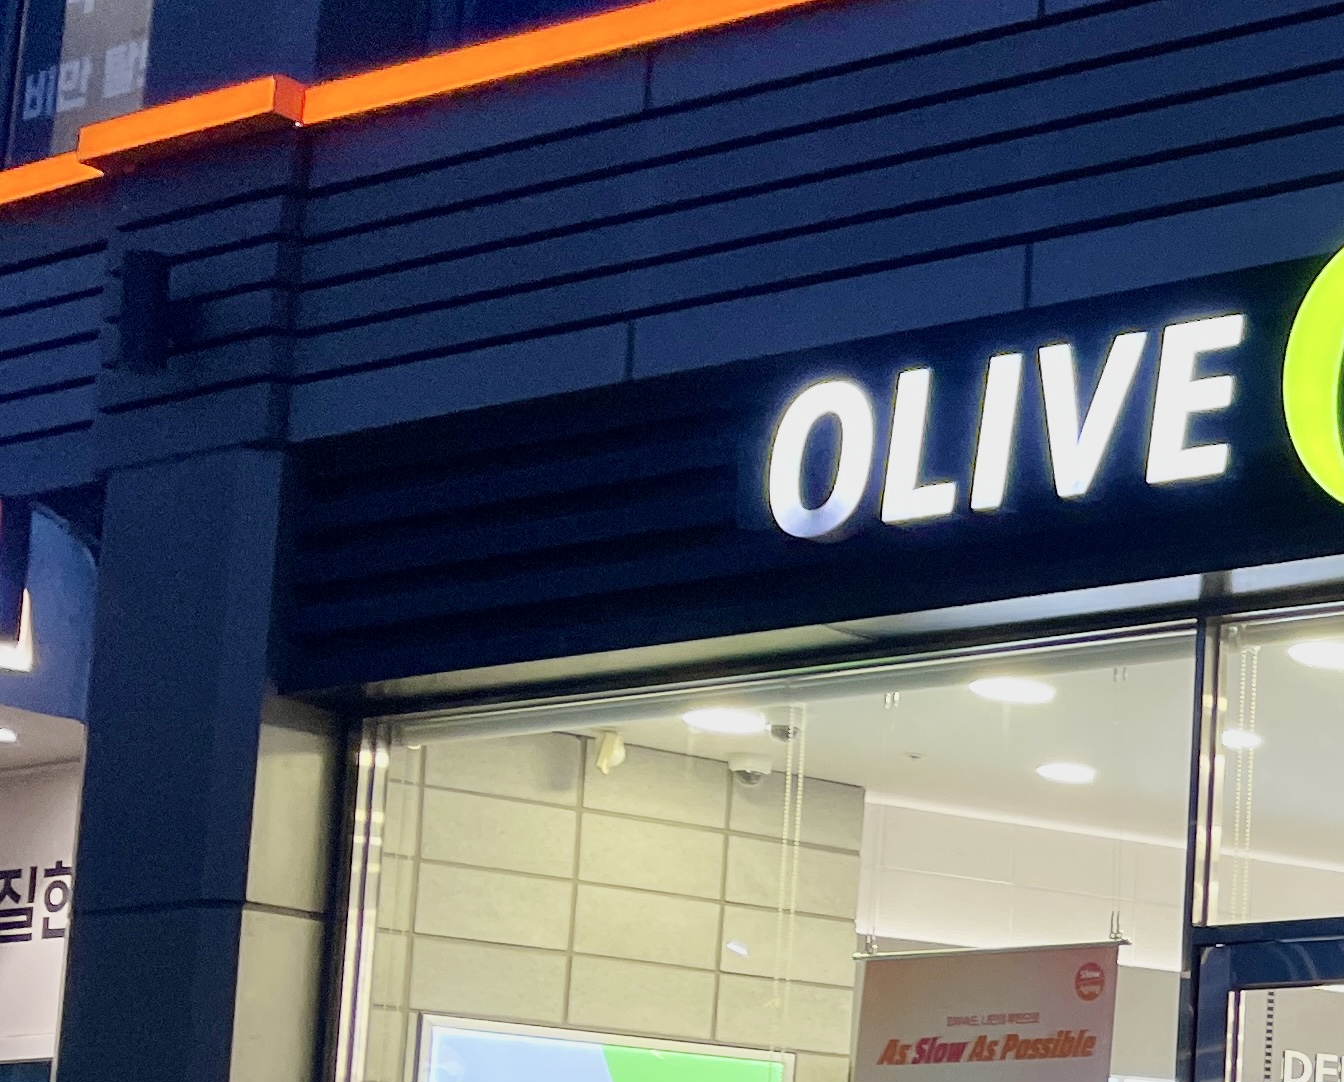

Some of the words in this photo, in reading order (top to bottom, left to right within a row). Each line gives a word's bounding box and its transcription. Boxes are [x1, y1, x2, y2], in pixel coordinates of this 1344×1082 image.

[766, 311, 1246, 541] OLIVE
[876, 1038, 911, 1066] As
[911, 1036, 971, 1065] Slow
[966, 1034, 1001, 1062] As
[1000, 1029, 1098, 1061] Possible
